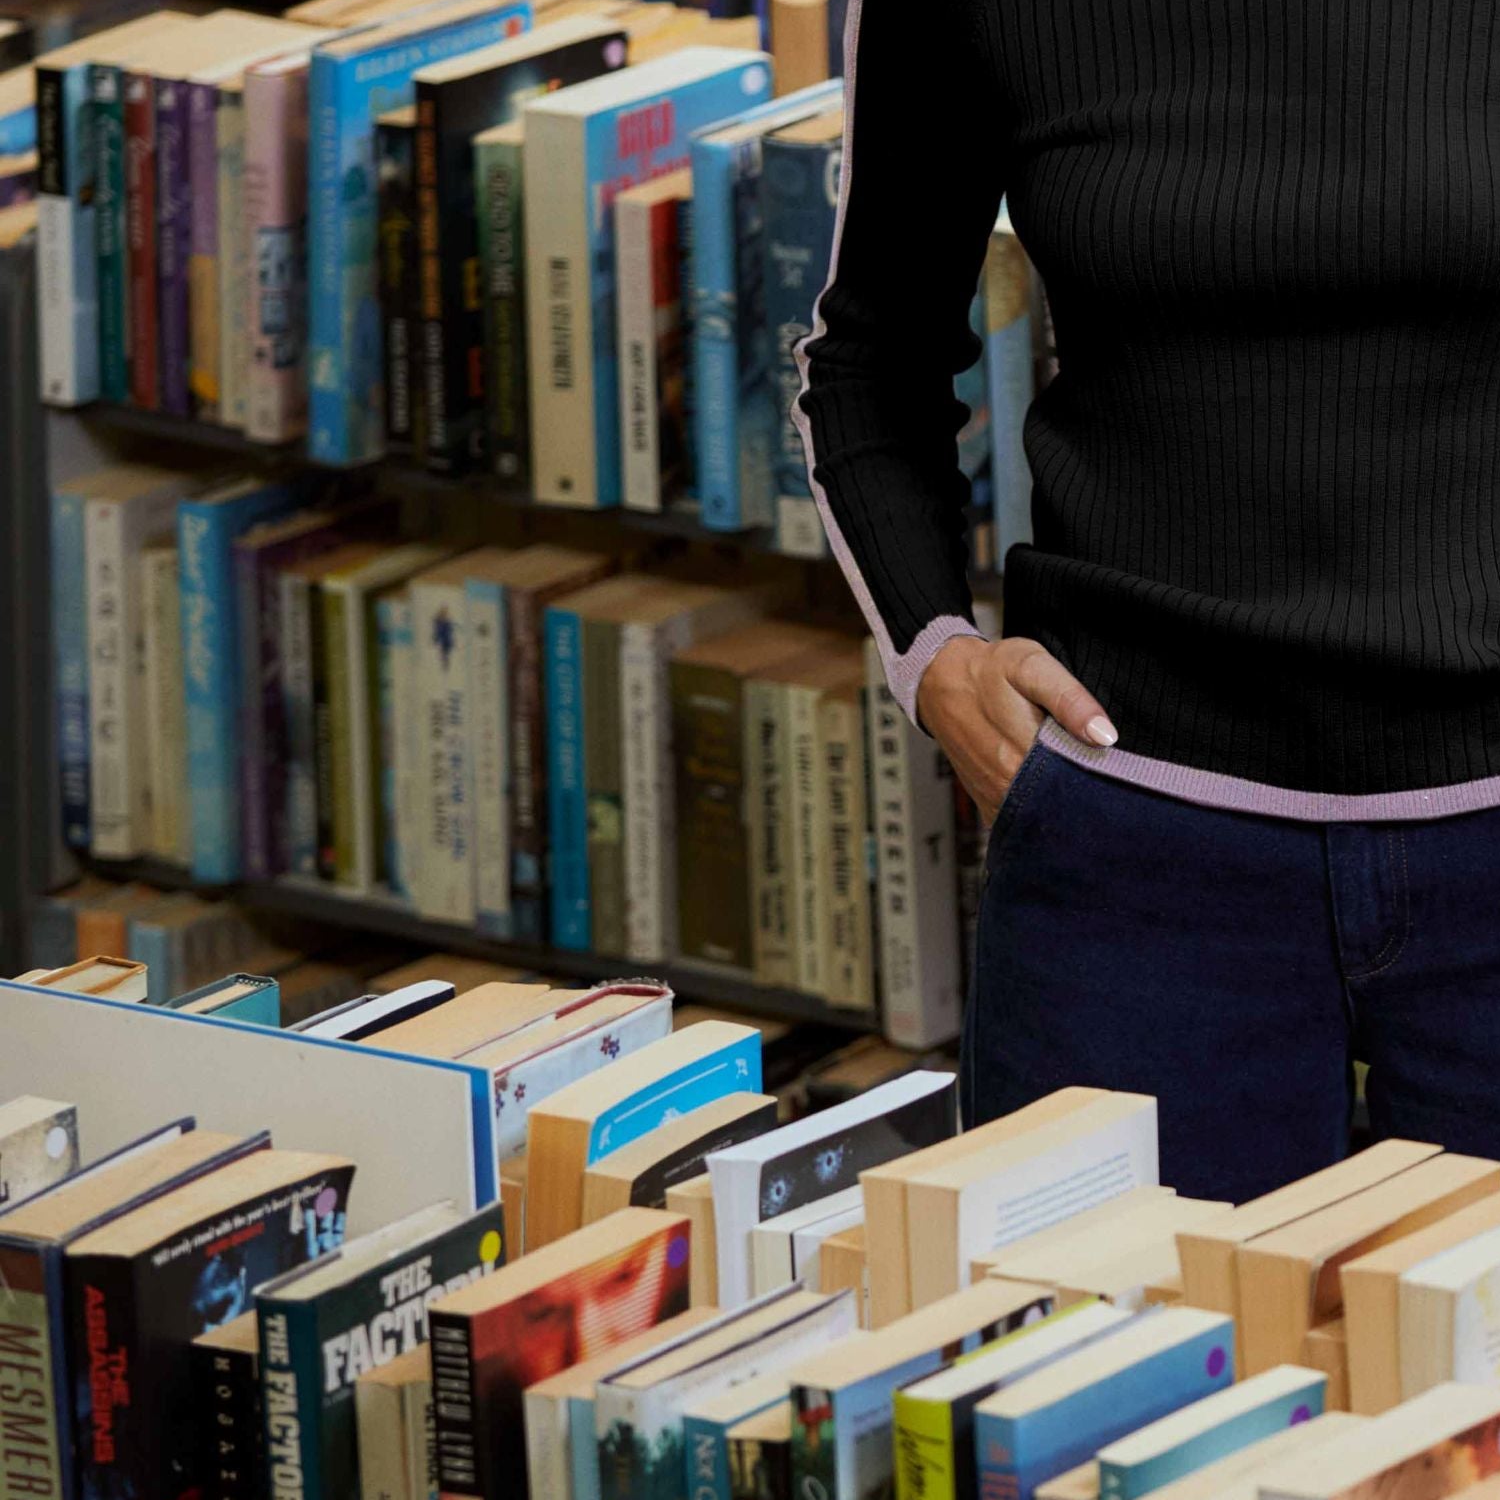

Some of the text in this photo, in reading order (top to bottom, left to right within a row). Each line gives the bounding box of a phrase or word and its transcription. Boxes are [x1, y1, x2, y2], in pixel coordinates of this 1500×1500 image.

[885, 802, 904, 916] TEETH
[380, 1255, 432, 1307] THE
[265, 1314, 289, 1364] THE
[84, 1284, 115, 1464] ASSASSINS
[111, 1347, 130, 1409] THE
[433, 1325, 476, 1485] MATTHEW LYNN
[695, 1435, 716, 1482] Not
